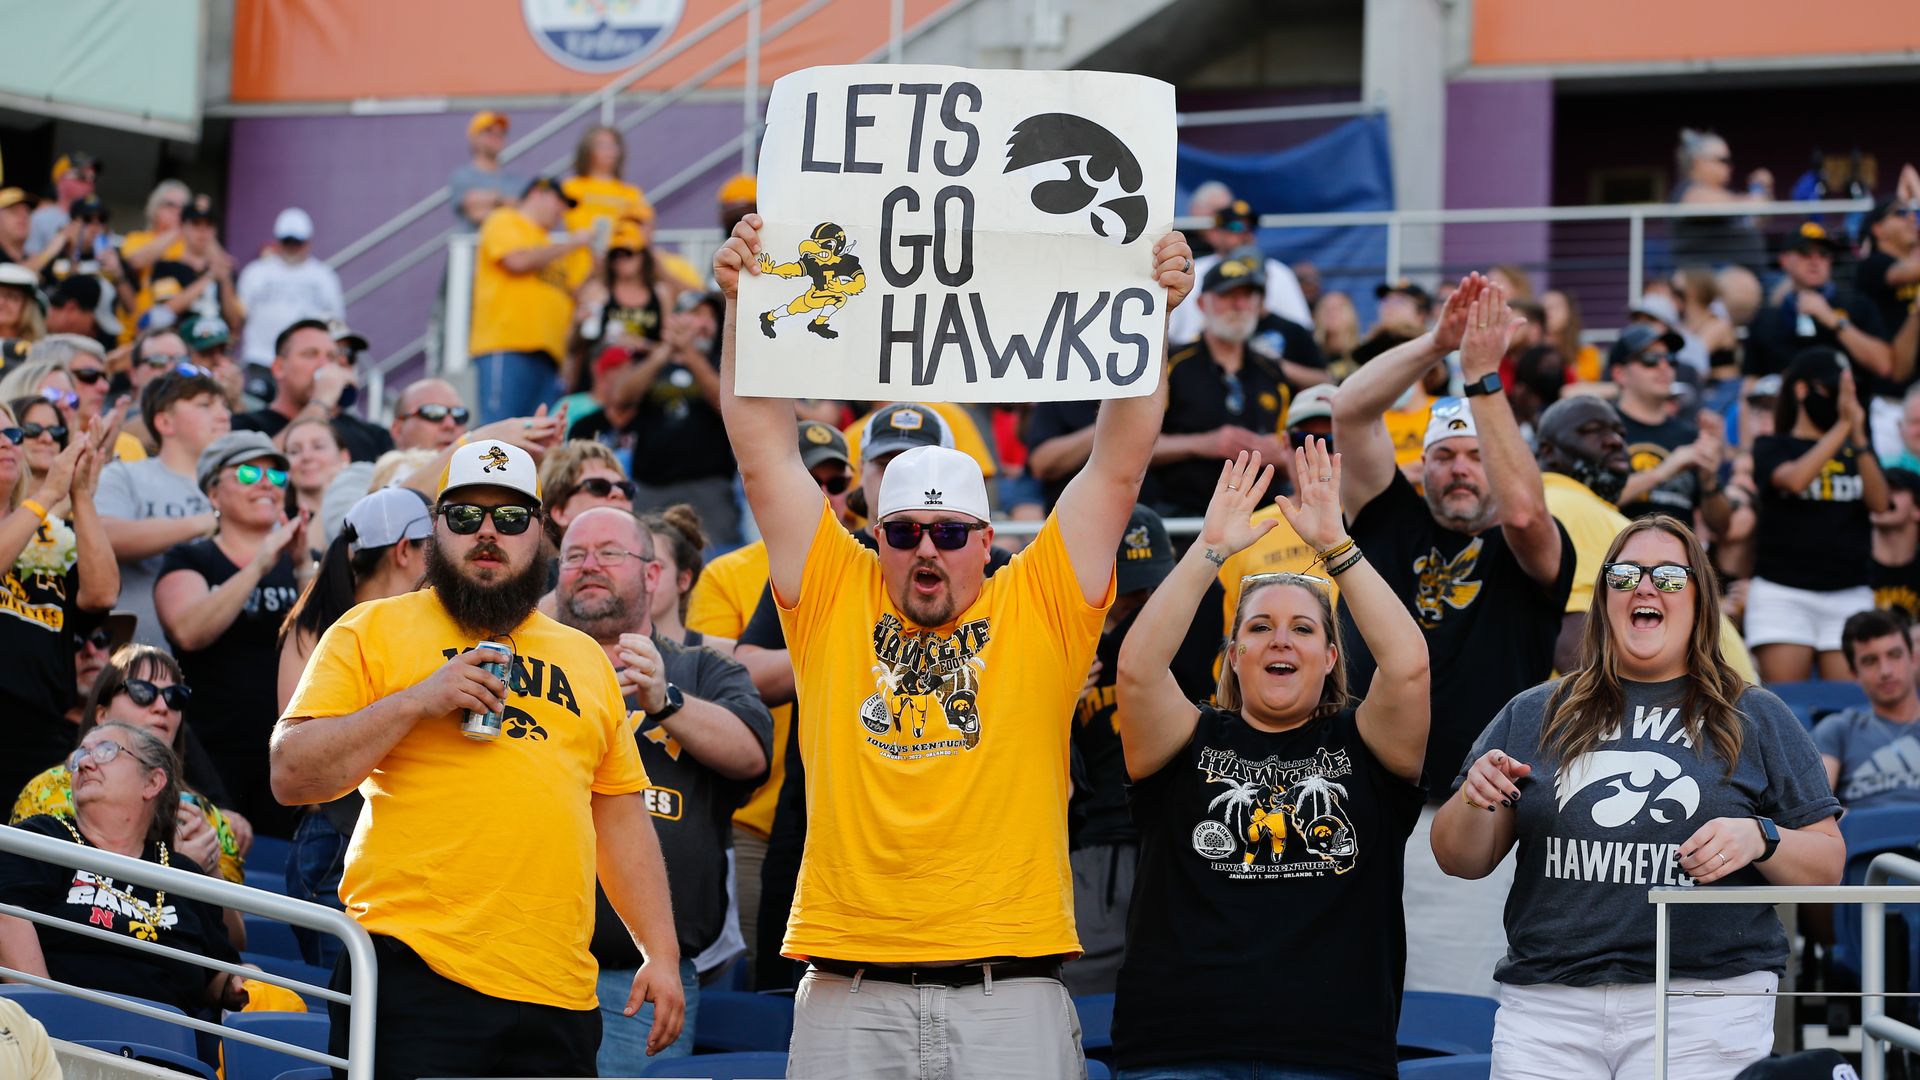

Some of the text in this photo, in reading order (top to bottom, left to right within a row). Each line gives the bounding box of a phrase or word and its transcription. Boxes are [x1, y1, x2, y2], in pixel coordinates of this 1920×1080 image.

[801, 81, 983, 177] LETS
[879, 184, 976, 288] GO
[878, 287, 1155, 387] HAWKS
[1195, 822, 1232, 841] CITRUS BOWL
[1248, 864, 1266, 873] VS
[1267, 861, 1340, 873] KENTUCKY
